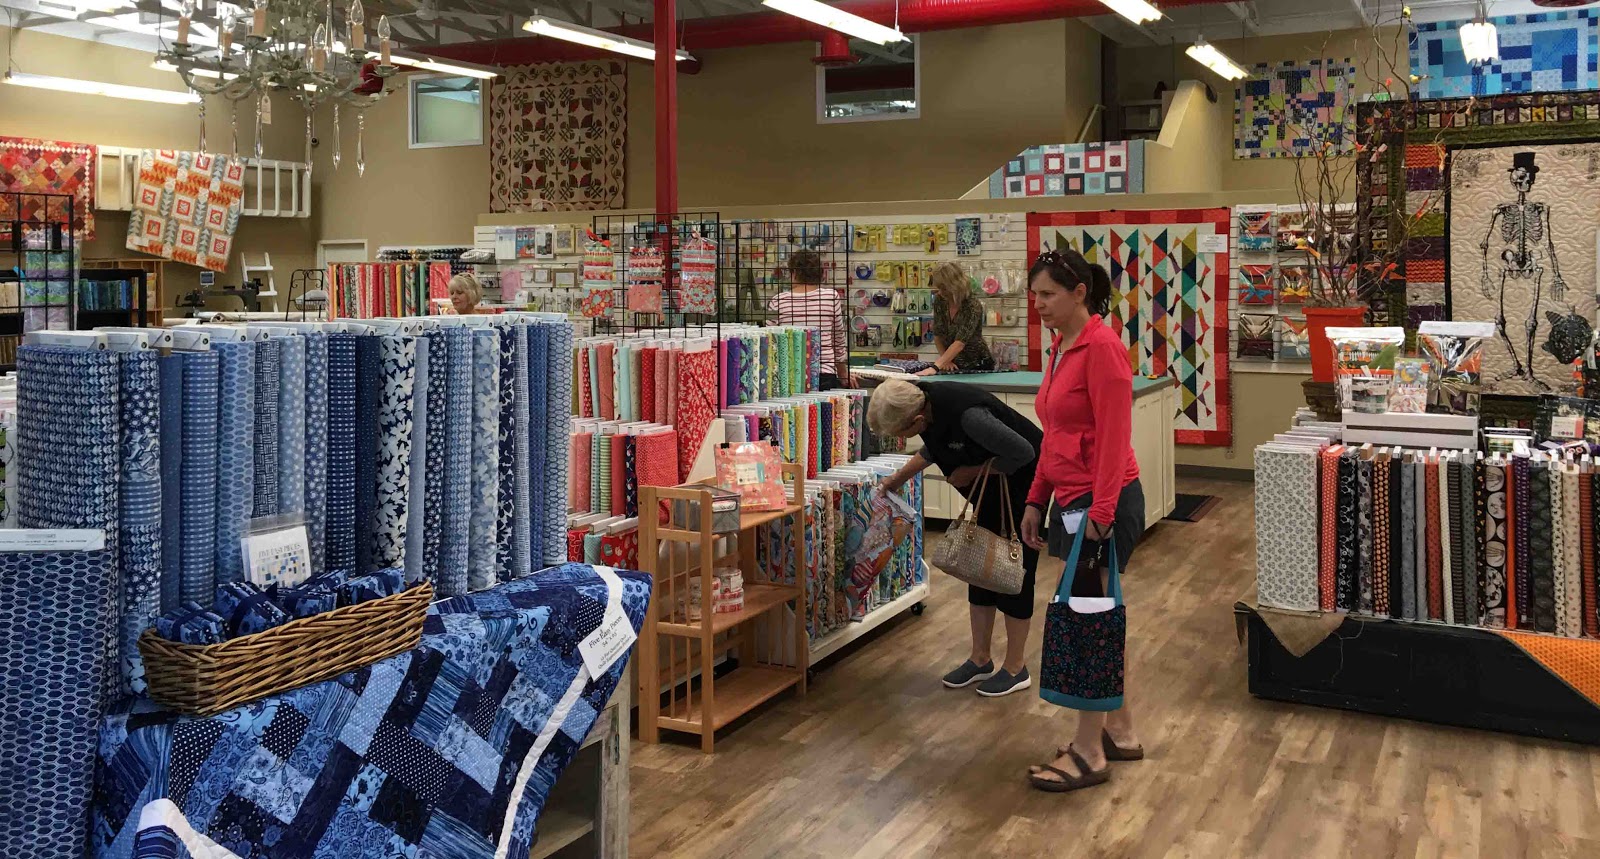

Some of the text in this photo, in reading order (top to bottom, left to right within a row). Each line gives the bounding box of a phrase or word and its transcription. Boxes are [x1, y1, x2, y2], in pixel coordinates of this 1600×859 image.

[588, 616, 623, 649] Five Easy Pieces
